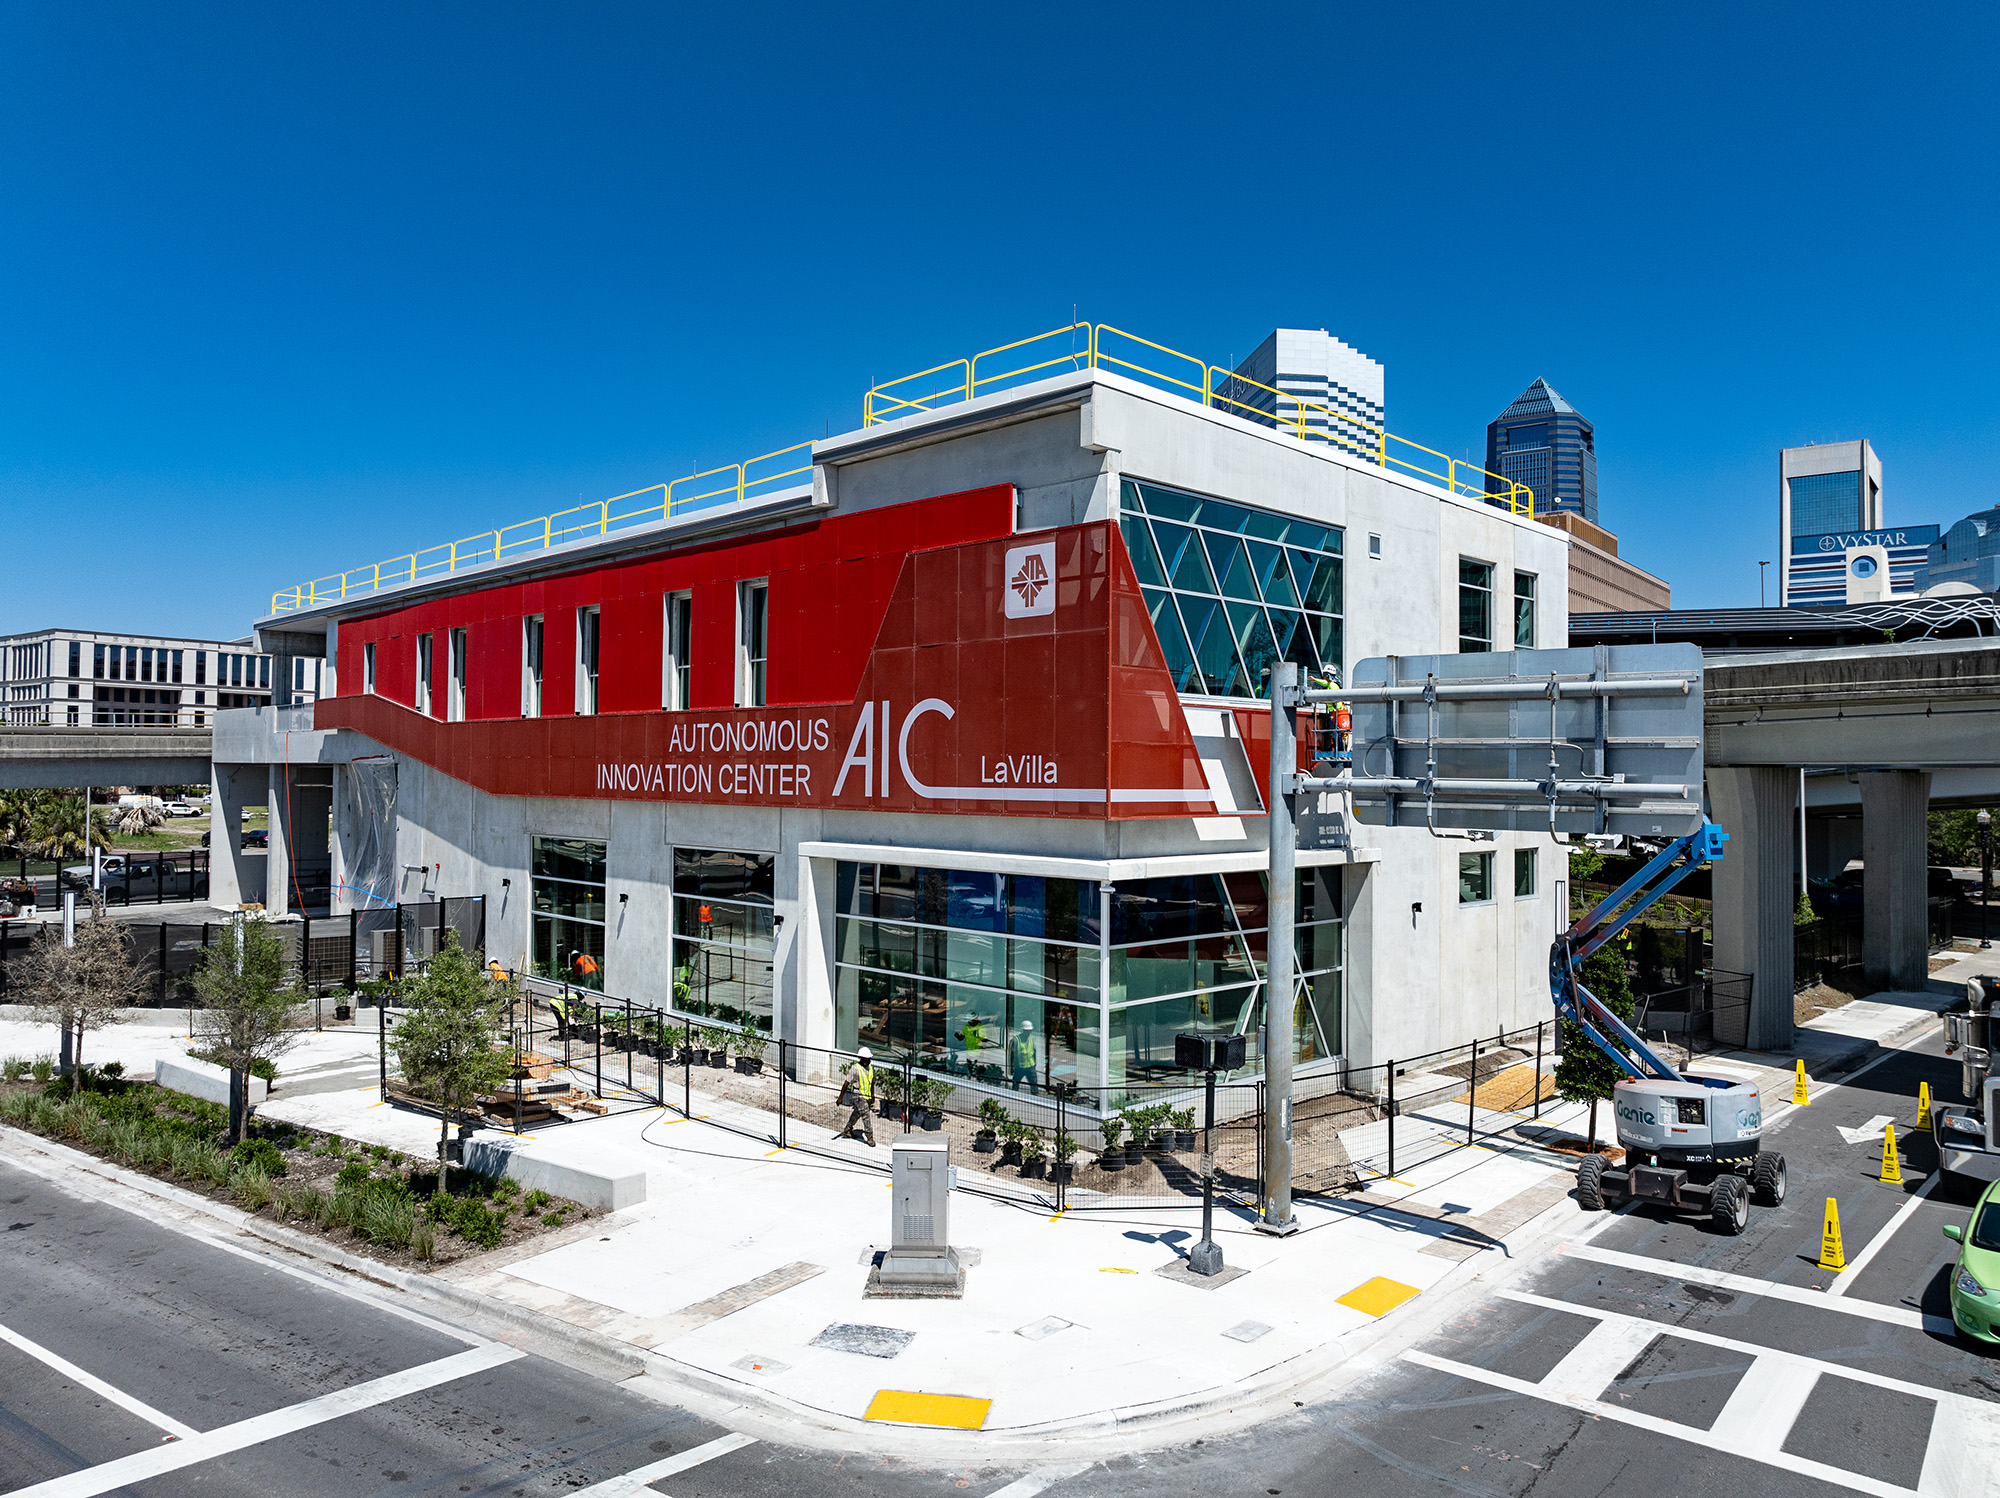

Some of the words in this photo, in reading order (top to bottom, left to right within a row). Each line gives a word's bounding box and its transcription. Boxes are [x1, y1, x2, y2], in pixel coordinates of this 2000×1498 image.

[668, 718, 829, 753] AUTONOMOUS
[832, 698, 955, 799] AIC
[597, 763, 712, 793] INNOVATION
[718, 764, 812, 796] CENTER
[981, 755, 1058, 784] LaVilla
[1617, 1099, 1655, 1125] Genie
